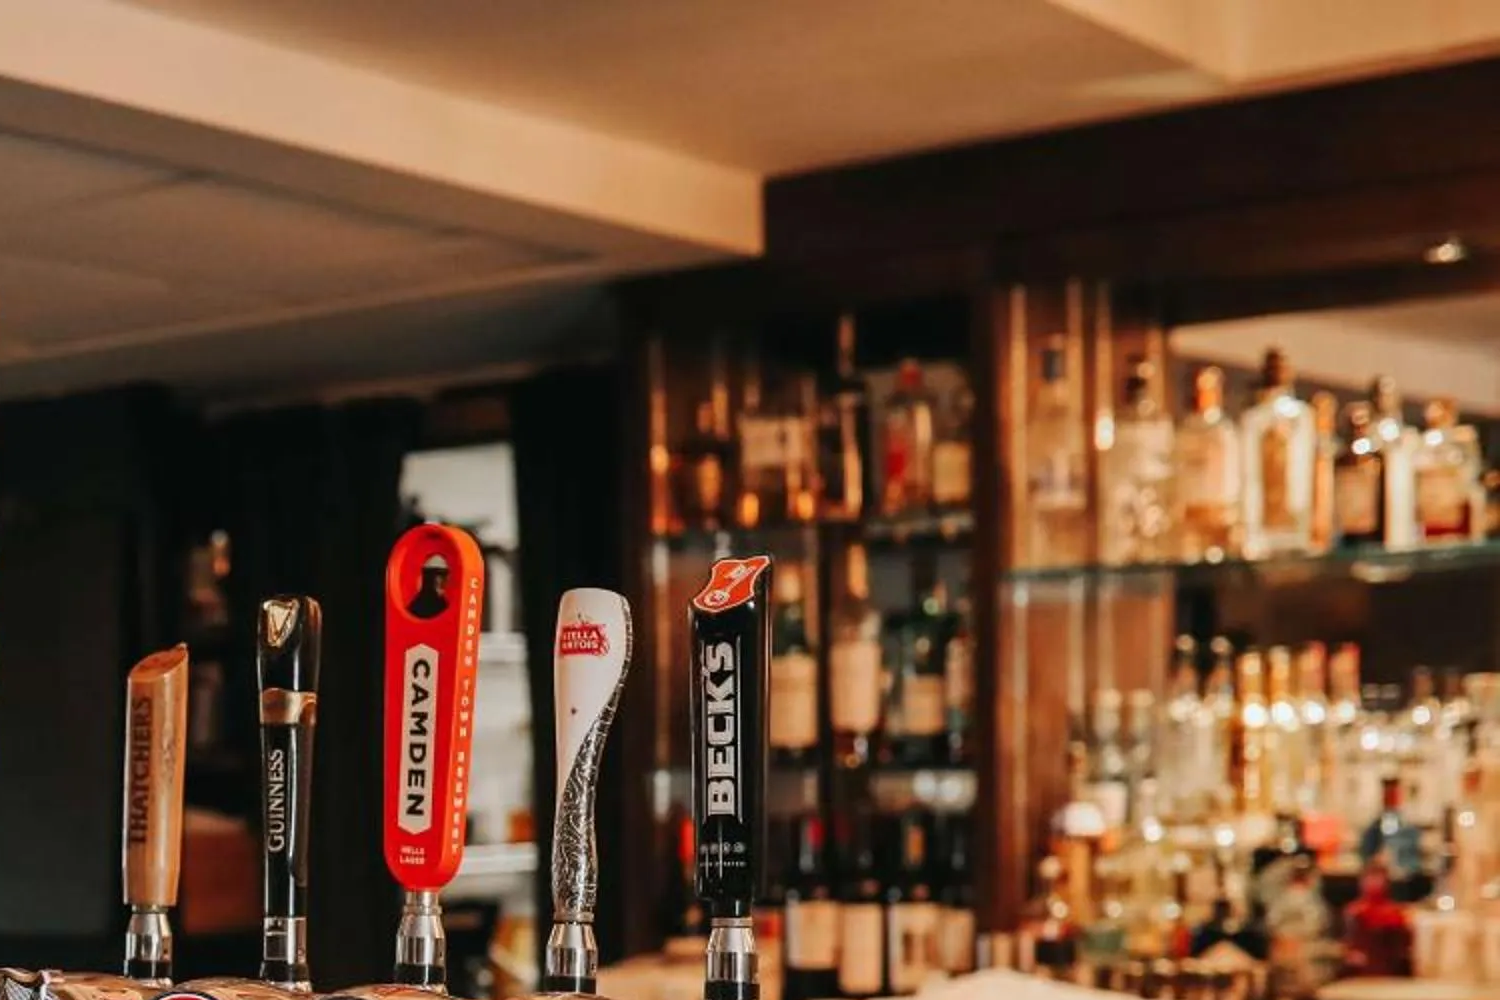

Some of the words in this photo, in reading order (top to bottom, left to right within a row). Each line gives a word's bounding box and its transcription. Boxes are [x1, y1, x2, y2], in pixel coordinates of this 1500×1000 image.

[128, 695, 151, 845] THATCHERS
[267, 749, 285, 853] GUINNESS
[405, 657, 431, 817] CAMDEN
[703, 640, 736, 817] BECK'S
